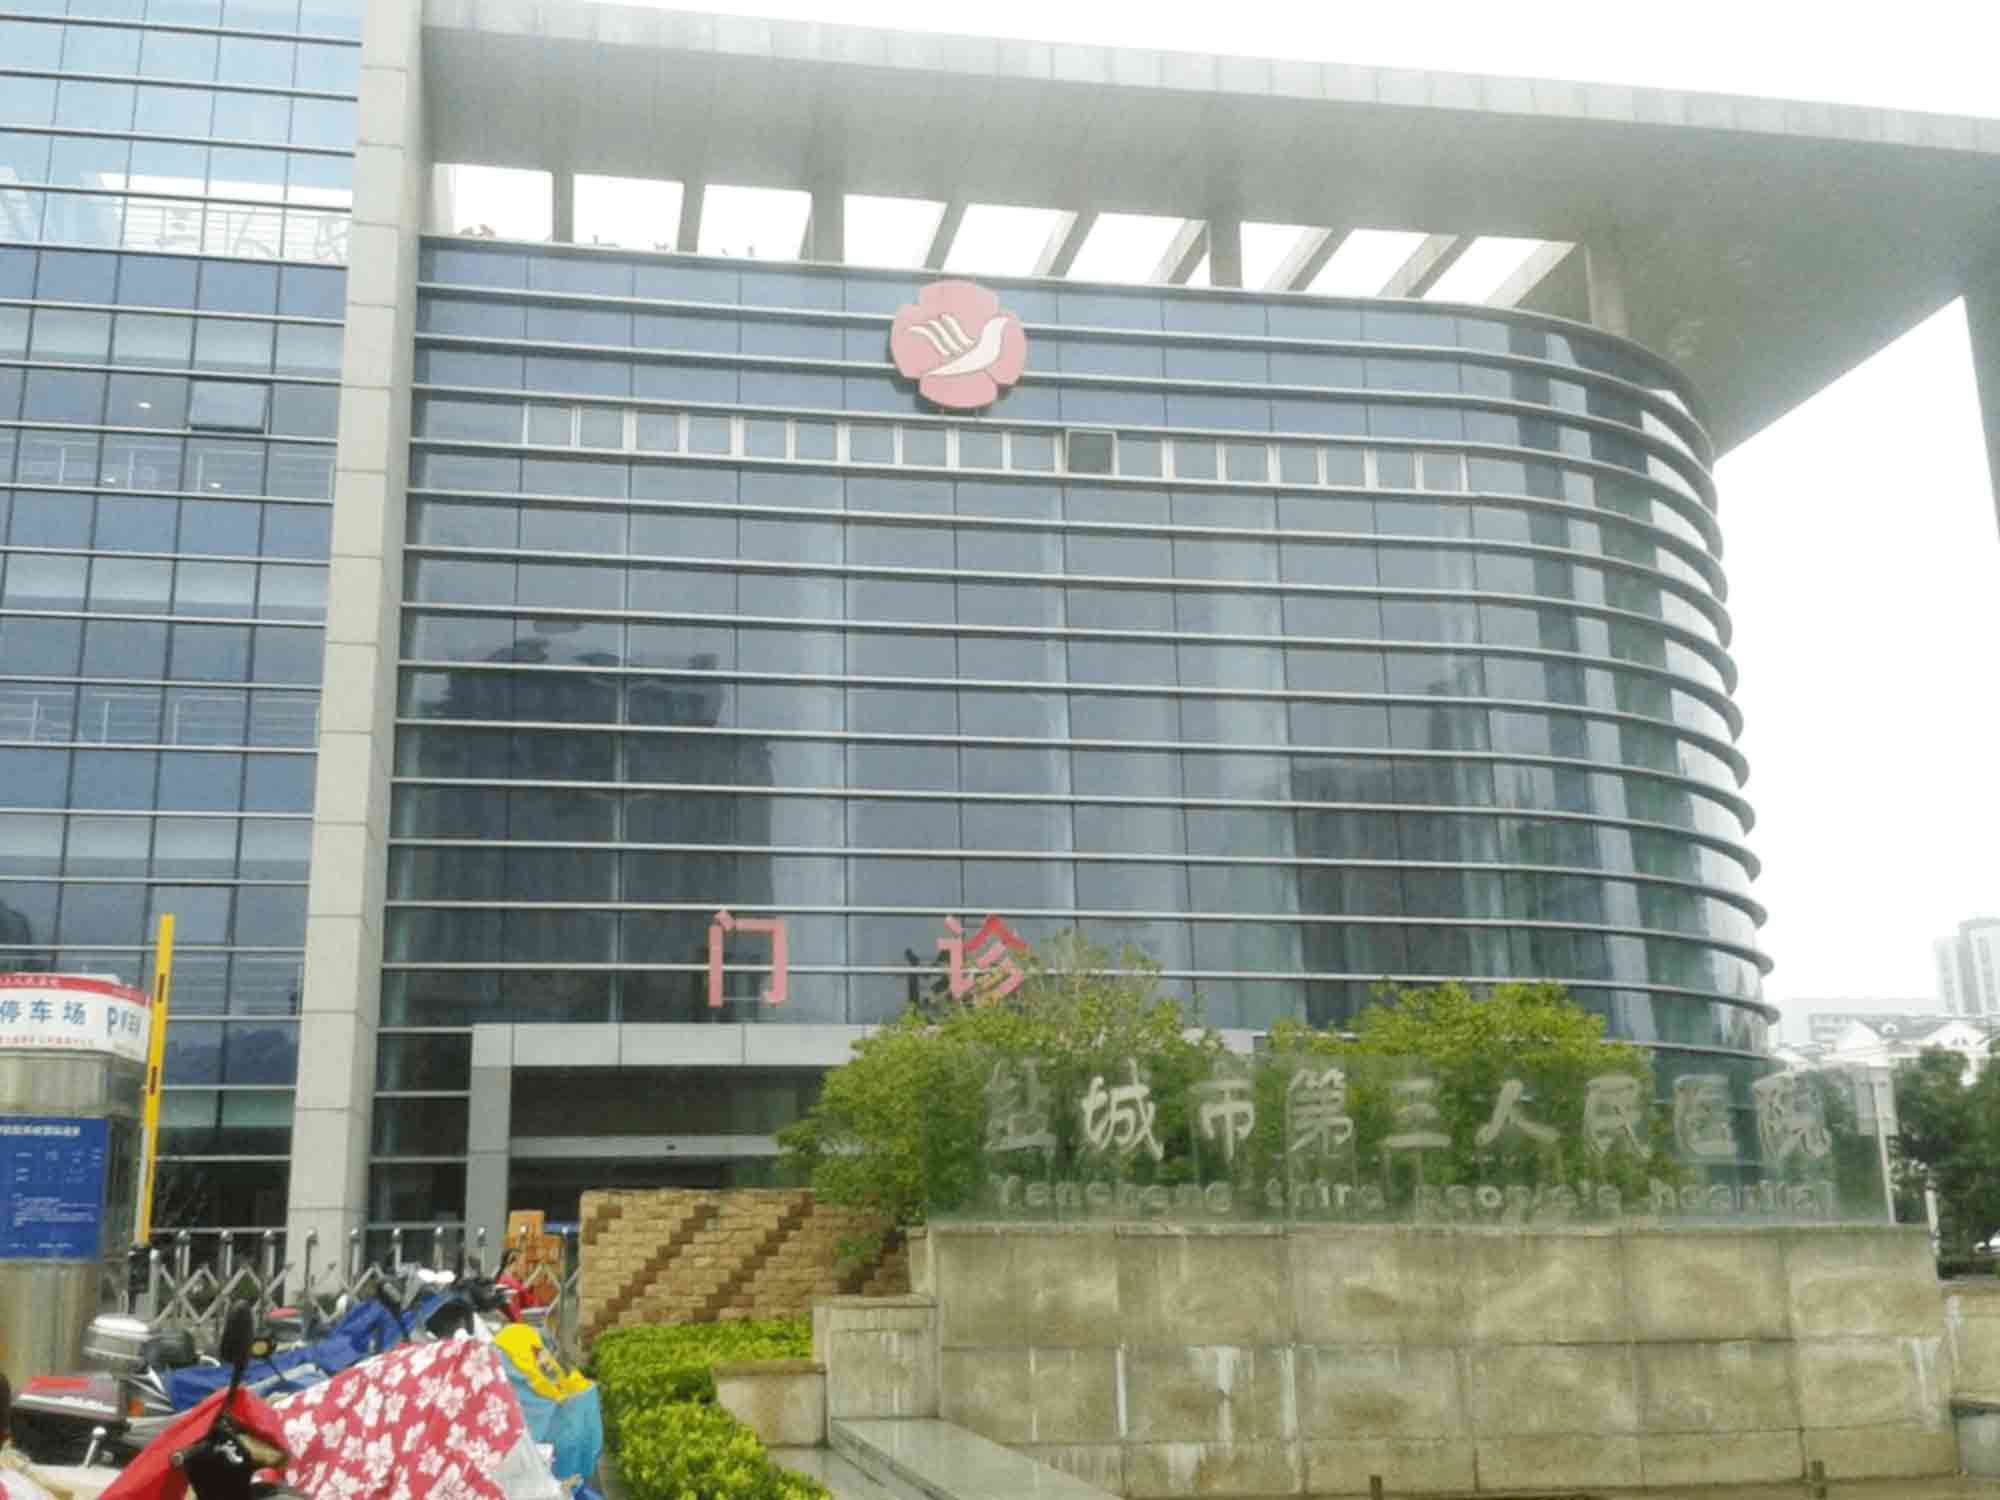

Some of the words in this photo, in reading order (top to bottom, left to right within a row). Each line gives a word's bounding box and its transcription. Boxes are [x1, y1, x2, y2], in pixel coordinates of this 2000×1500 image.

[708, 911, 1028, 1008] 门诊
[0, 999, 88, 1026] 停车场
[983, 1058, 1833, 1162] 盐城市第三人民医院
